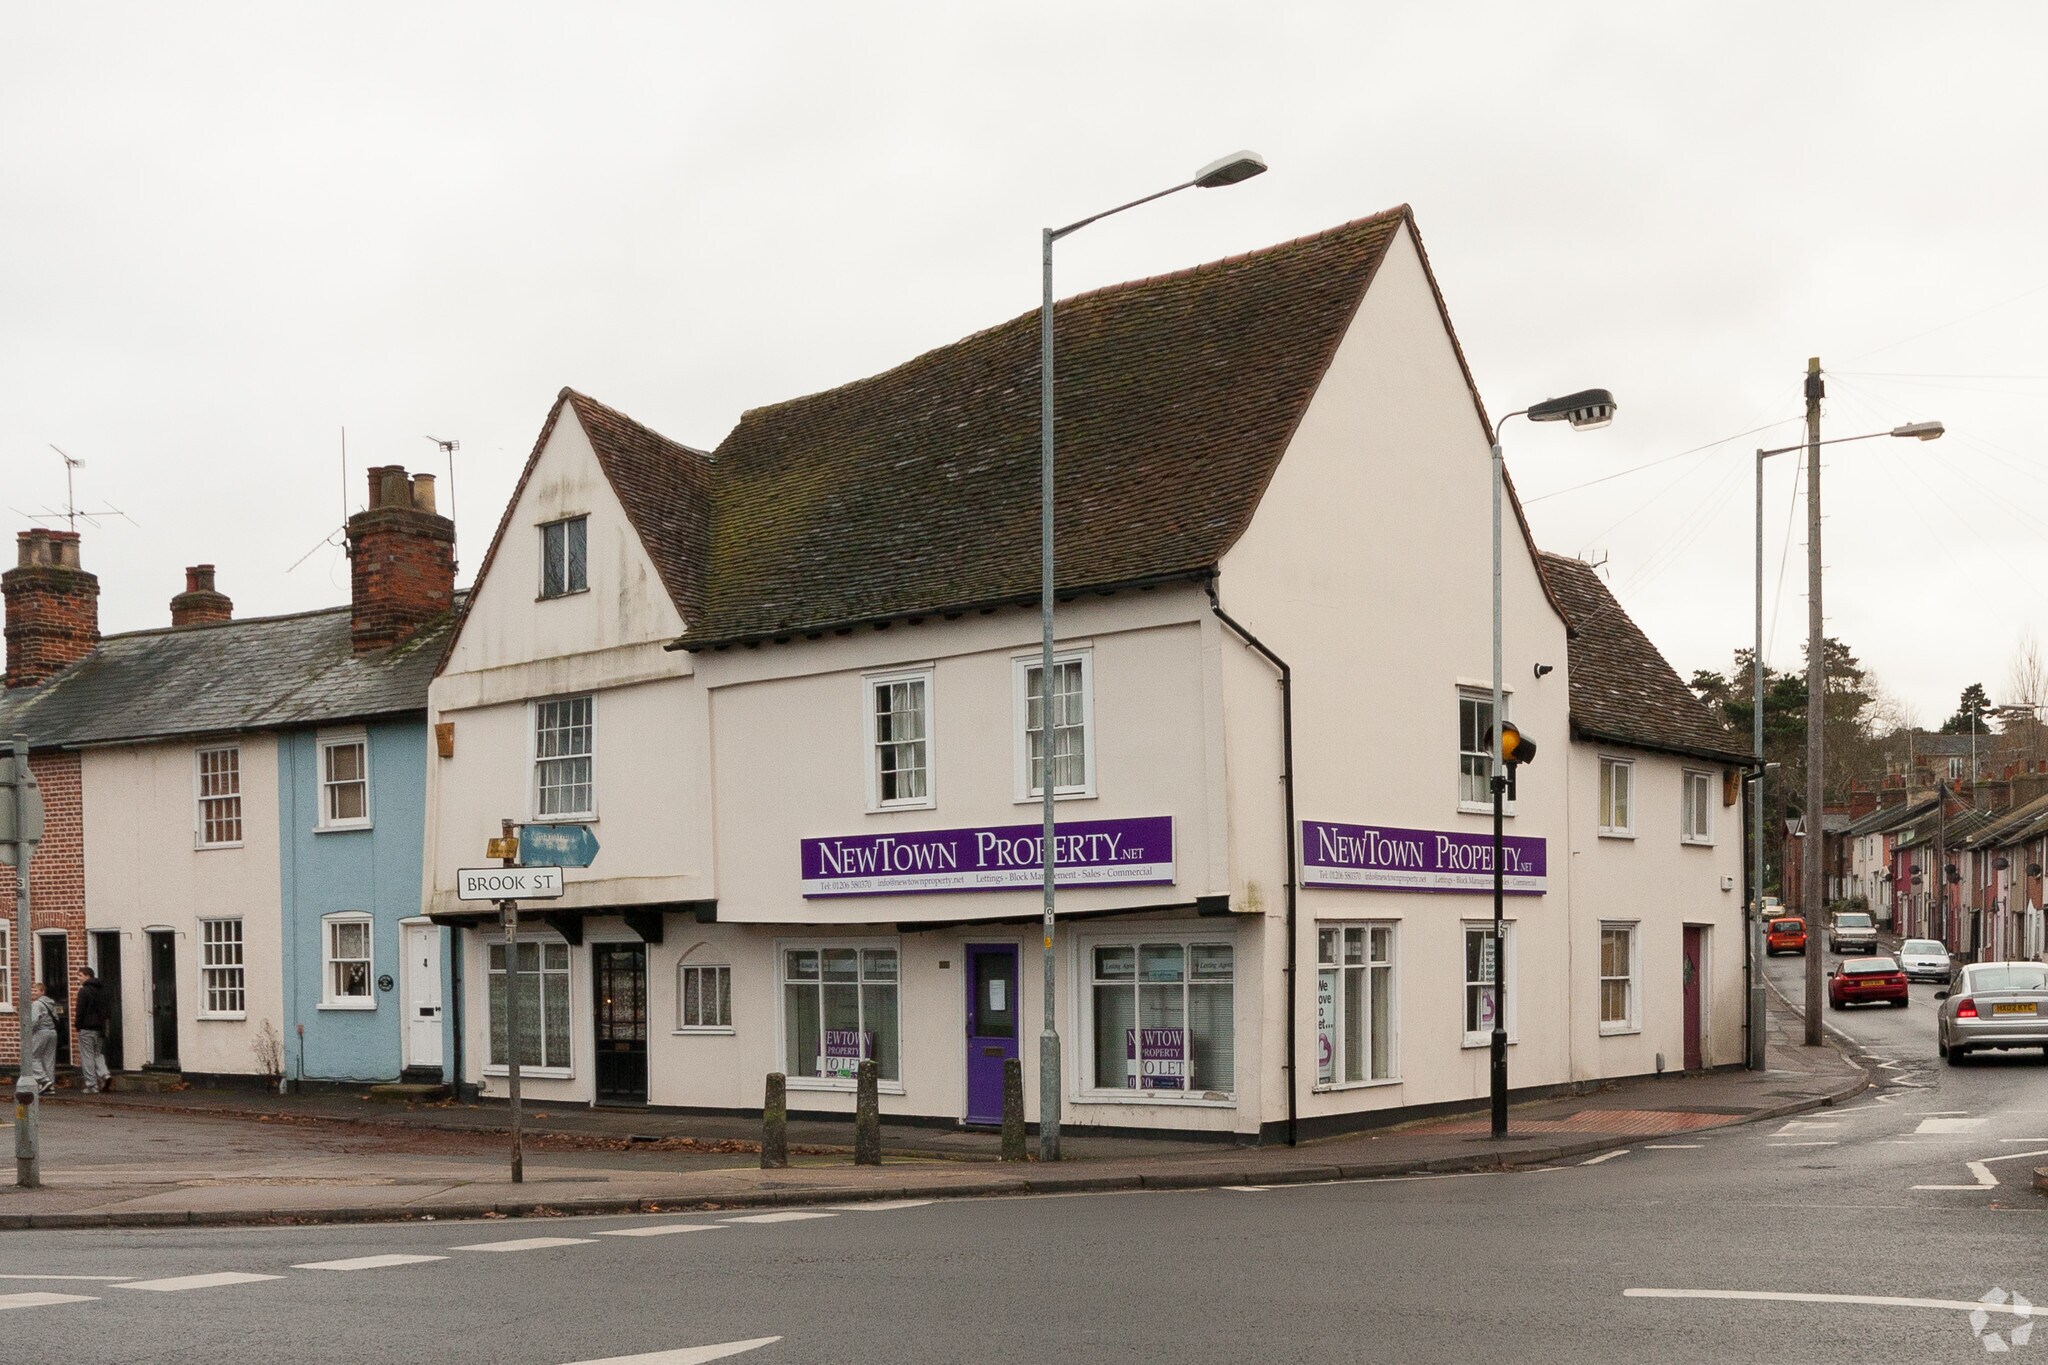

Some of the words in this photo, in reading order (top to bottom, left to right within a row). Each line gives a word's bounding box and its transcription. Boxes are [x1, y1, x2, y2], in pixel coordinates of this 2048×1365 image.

[832, 881, 850, 890] 01206
[976, 873, 1003, 884] Lettings
[1009, 872, 1029, 882] Block
[1030, 871, 1076, 882] Manement
[1082, 869, 1101, 878] Sales
[1107, 866, 1152, 878] Commercial
[467, 875, 526, 892] BROOK
[533, 875, 554, 889] ST
[1318, 994, 1332, 1004] ove
[1318, 1018, 1333, 1029] et...
[827, 1046, 859, 1055] PROPERTY
[1143, 1048, 1180, 1057] ROPERTY
